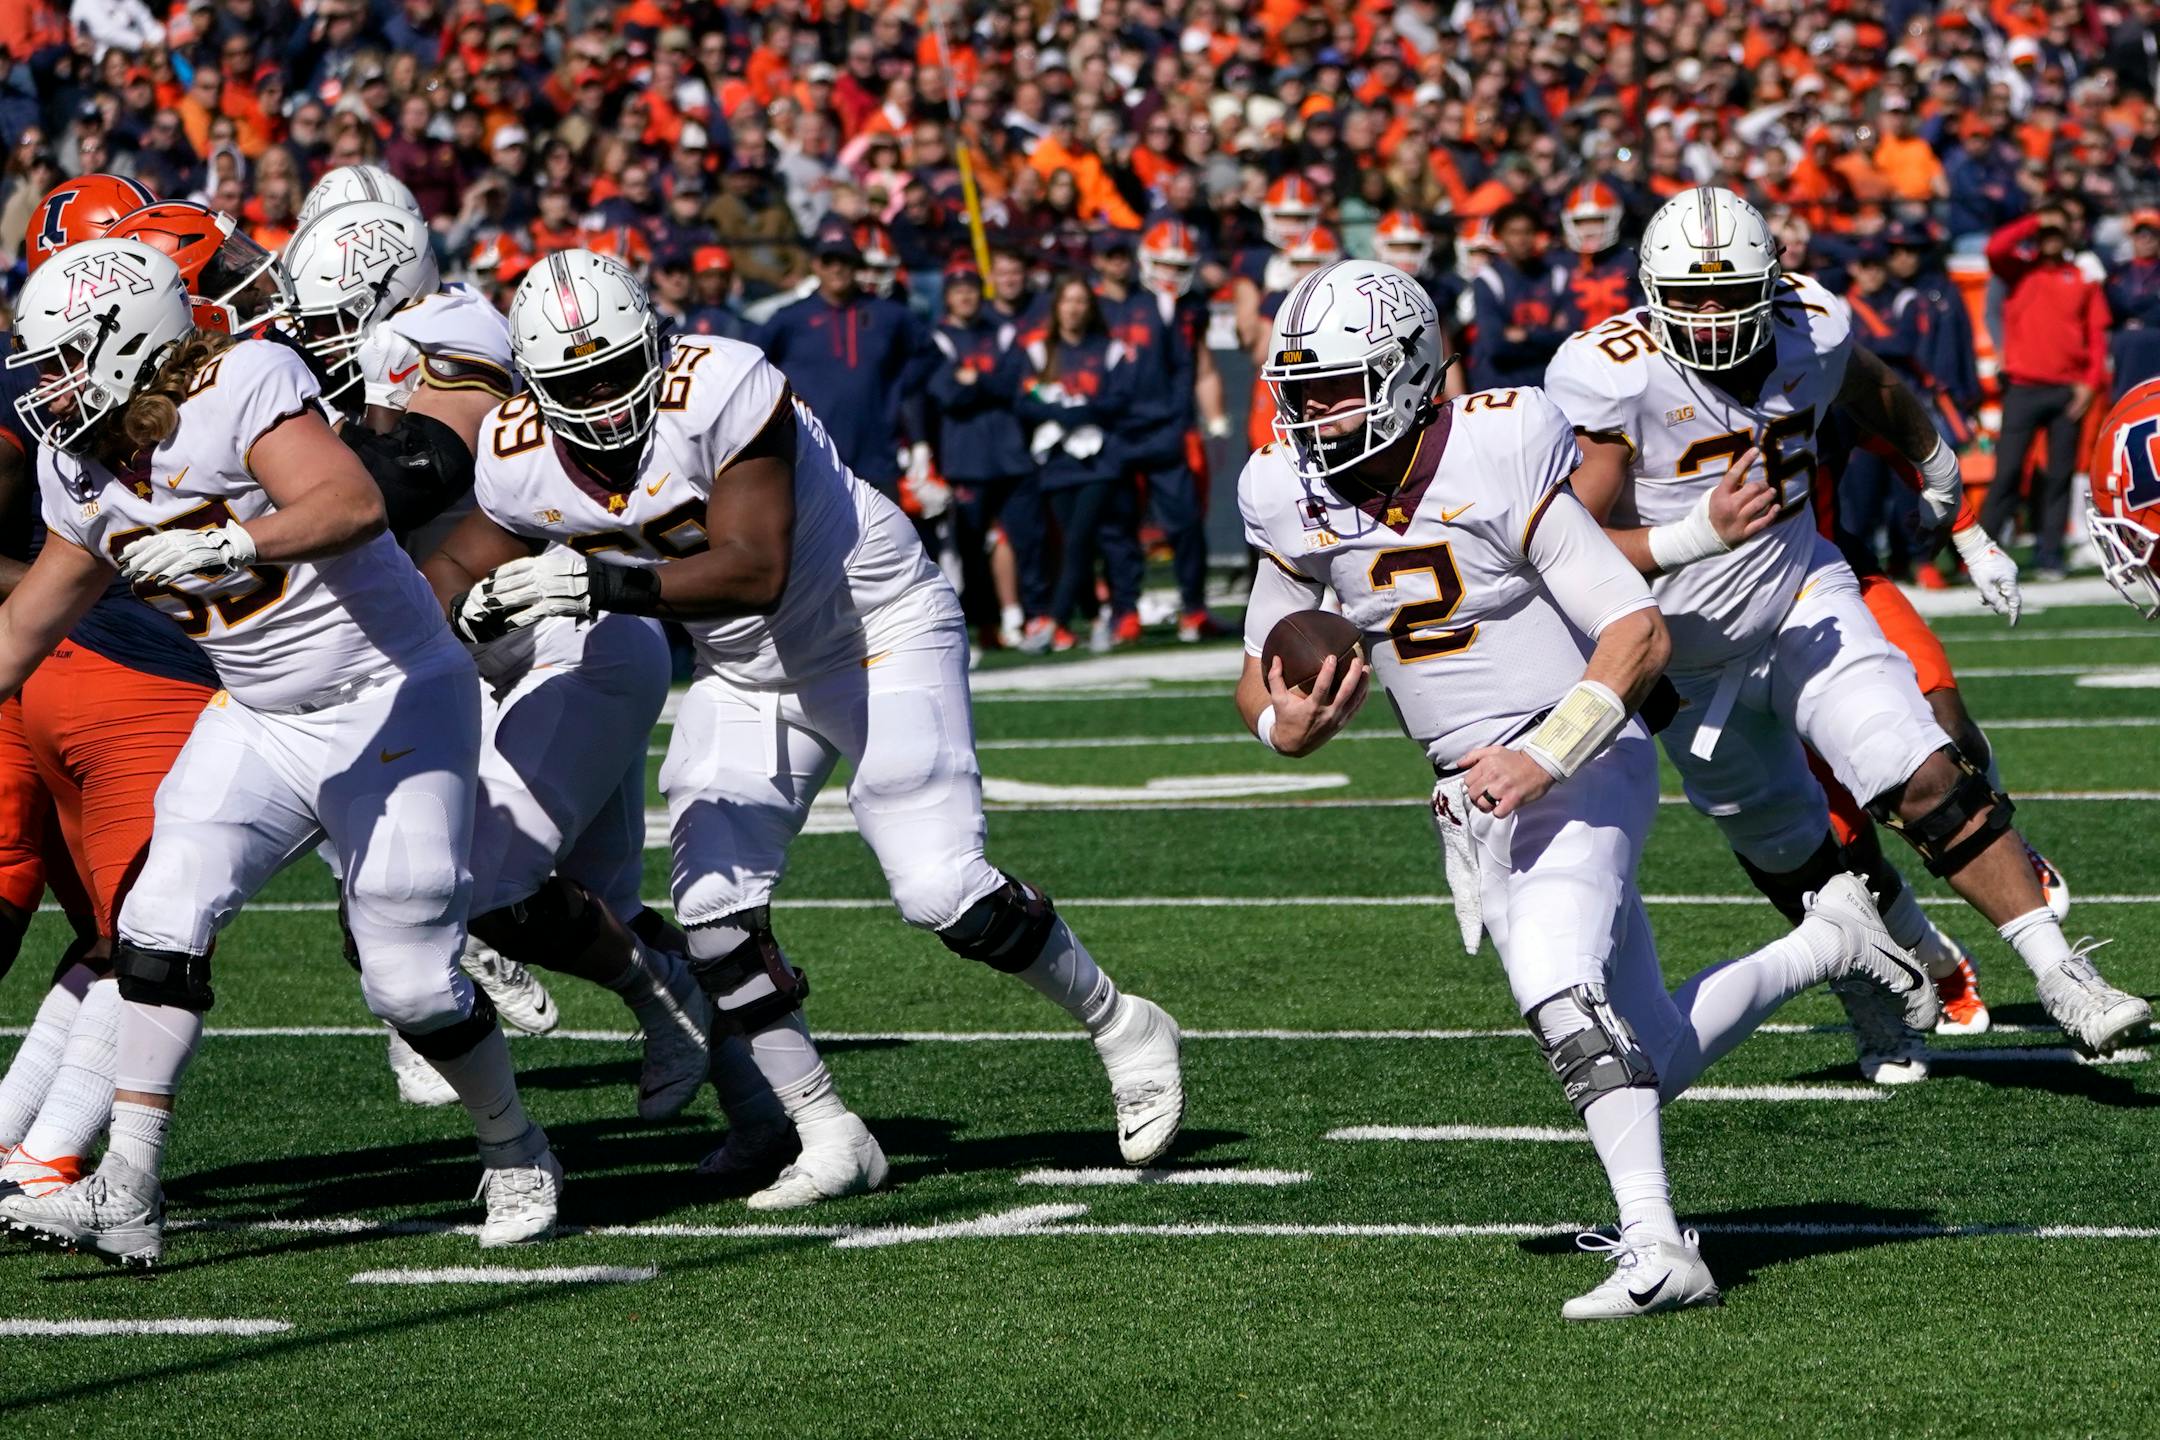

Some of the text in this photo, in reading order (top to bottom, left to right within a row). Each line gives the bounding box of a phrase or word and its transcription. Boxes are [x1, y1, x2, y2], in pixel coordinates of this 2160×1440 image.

[63, 251, 154, 322] M
[333, 219, 417, 291] M
[1356, 274, 1436, 344] M
[1283, 351, 1302, 364] ROW
[1367, 540, 1480, 665] 2
